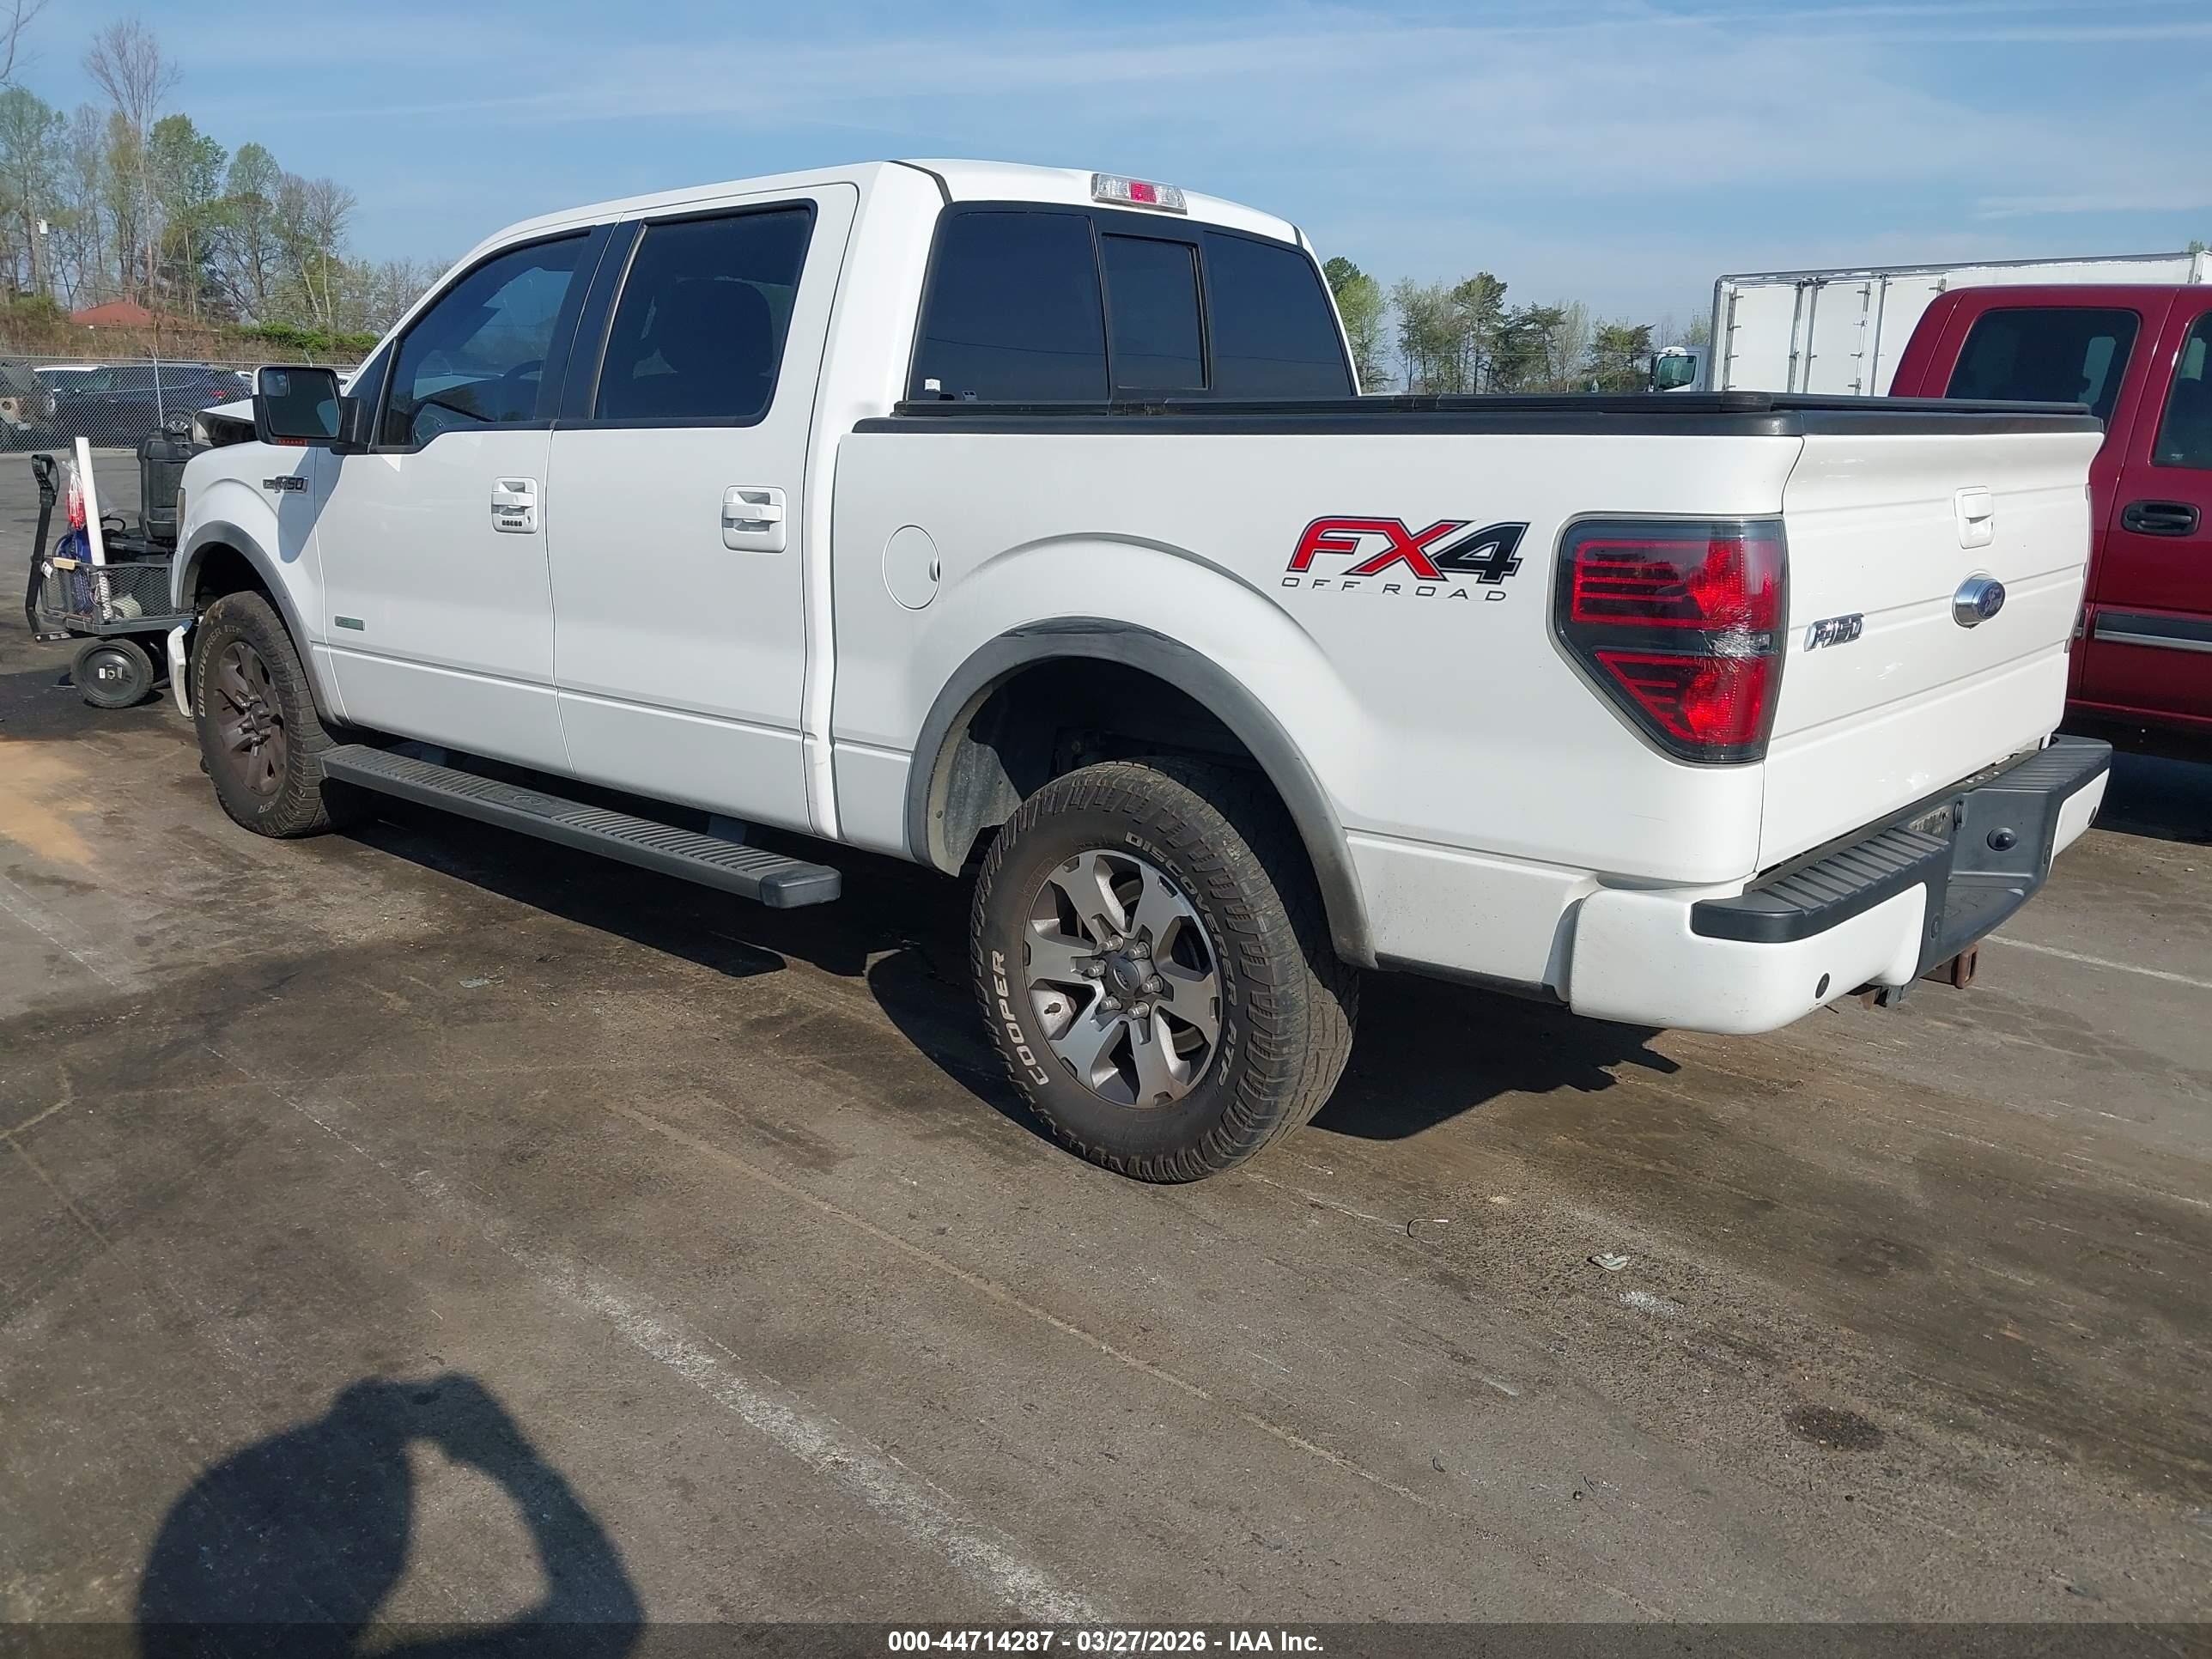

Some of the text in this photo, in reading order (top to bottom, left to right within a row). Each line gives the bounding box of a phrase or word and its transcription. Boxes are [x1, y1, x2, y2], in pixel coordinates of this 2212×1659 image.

[1280, 576, 1507, 602] OFF ROAD
[1285, 514, 1532, 586] FX4
[197, 627, 223, 718] DISCOVERER
[1124, 830, 1237, 1087] DISCOVERER ATP
[989, 949, 1050, 1086] COOPER
